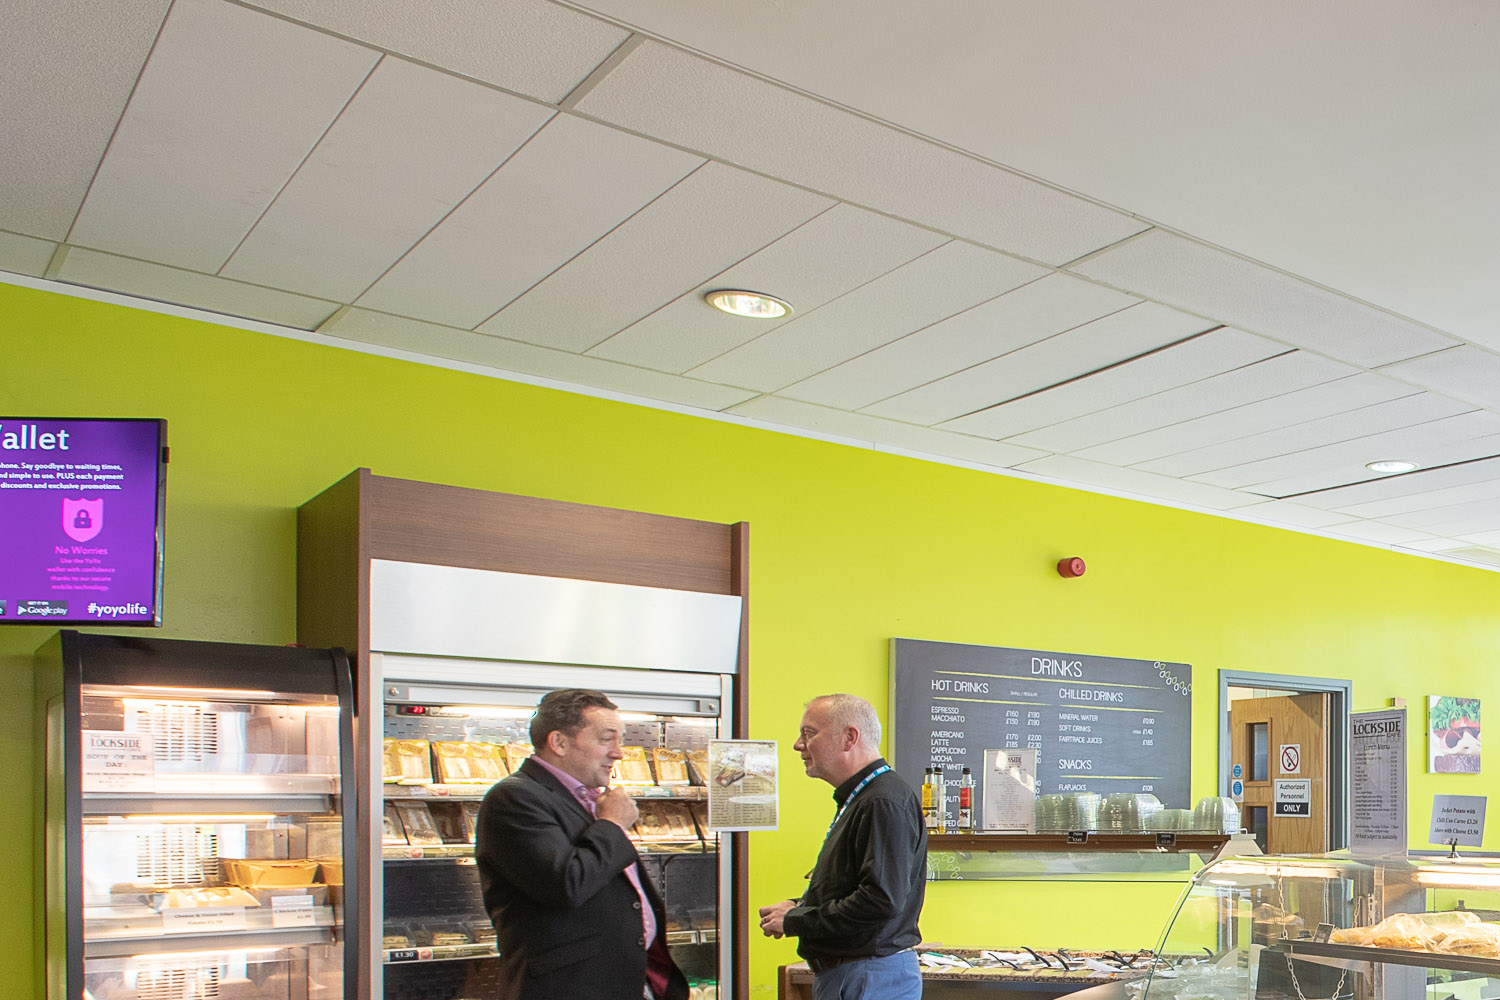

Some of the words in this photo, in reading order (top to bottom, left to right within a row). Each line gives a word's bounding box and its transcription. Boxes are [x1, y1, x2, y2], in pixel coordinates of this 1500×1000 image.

[0, 424, 70, 450] allet
[21, 462, 33, 471] Say
[34, 463, 65, 471] goodbye
[9, 472, 31, 480] simple
[54, 546, 69, 554] No
[71, 546, 108, 555] Worries
[27, 606, 52, 616] Google
[53, 607, 68, 615] play
[87, 602, 147, 617] #yoyolife
[1031, 657, 1083, 678] DRINKS
[931, 680, 951, 691] HOT
[954, 681, 989, 693] DRINKS
[1059, 688, 1092, 701] CHILLED
[1093, 690, 1123, 703] DRINKS
[931, 706, 959, 714] ESPRESSO
[931, 715, 965, 723] MACCHIATO
[1059, 713, 1080, 721] MINERAL
[1353, 721, 1401, 735] LOCKSIDE
[931, 731, 964, 739] AMERICANO
[931, 747, 966, 755] CAPPUCCINO
[1058, 759, 1092, 770] SNACKS
[1283, 804, 1301, 812] ONLY
